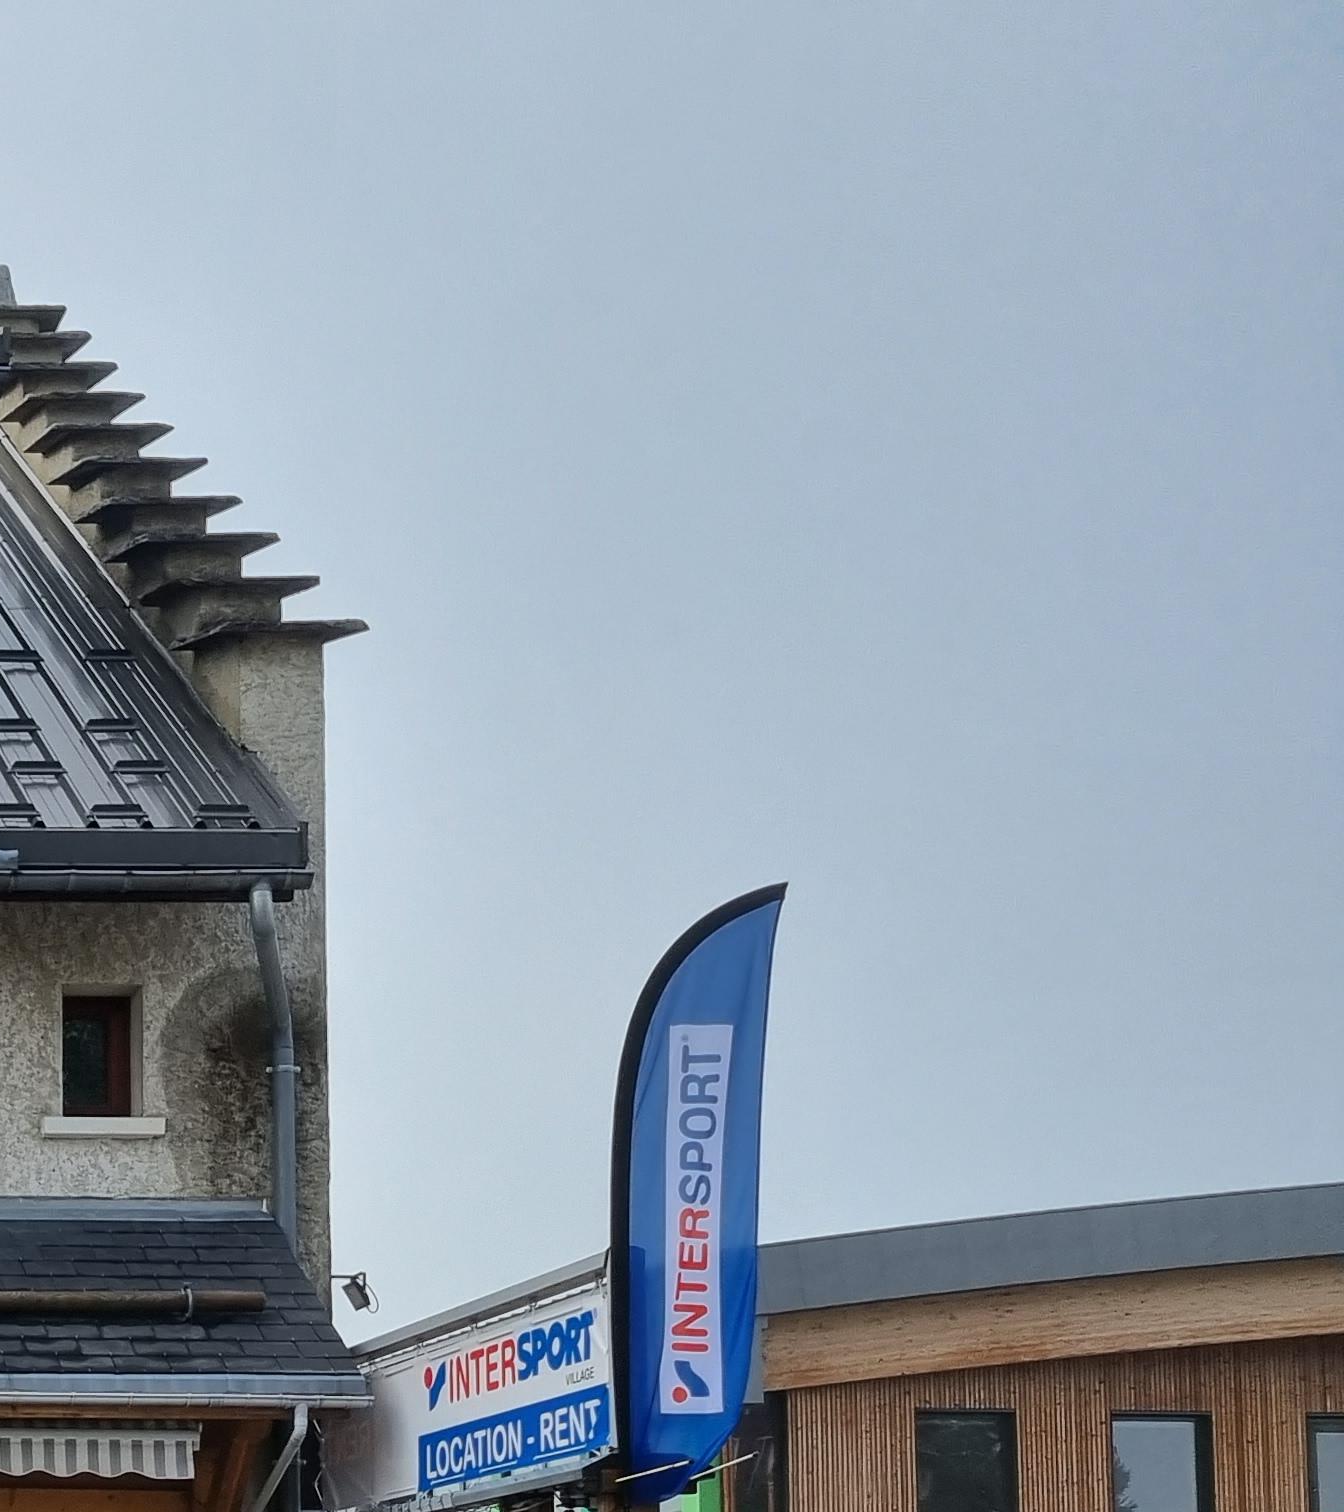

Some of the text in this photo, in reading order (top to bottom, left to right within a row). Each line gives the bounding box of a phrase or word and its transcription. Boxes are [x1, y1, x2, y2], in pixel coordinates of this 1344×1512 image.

[670, 1054, 722, 1353] INTERSPORT
[449, 1310, 594, 1403] INTERSPORT
[566, 1367, 595, 1386] VILLAGE
[426, 1419, 522, 1480] LOCATION
[539, 1399, 601, 1452] RENT
